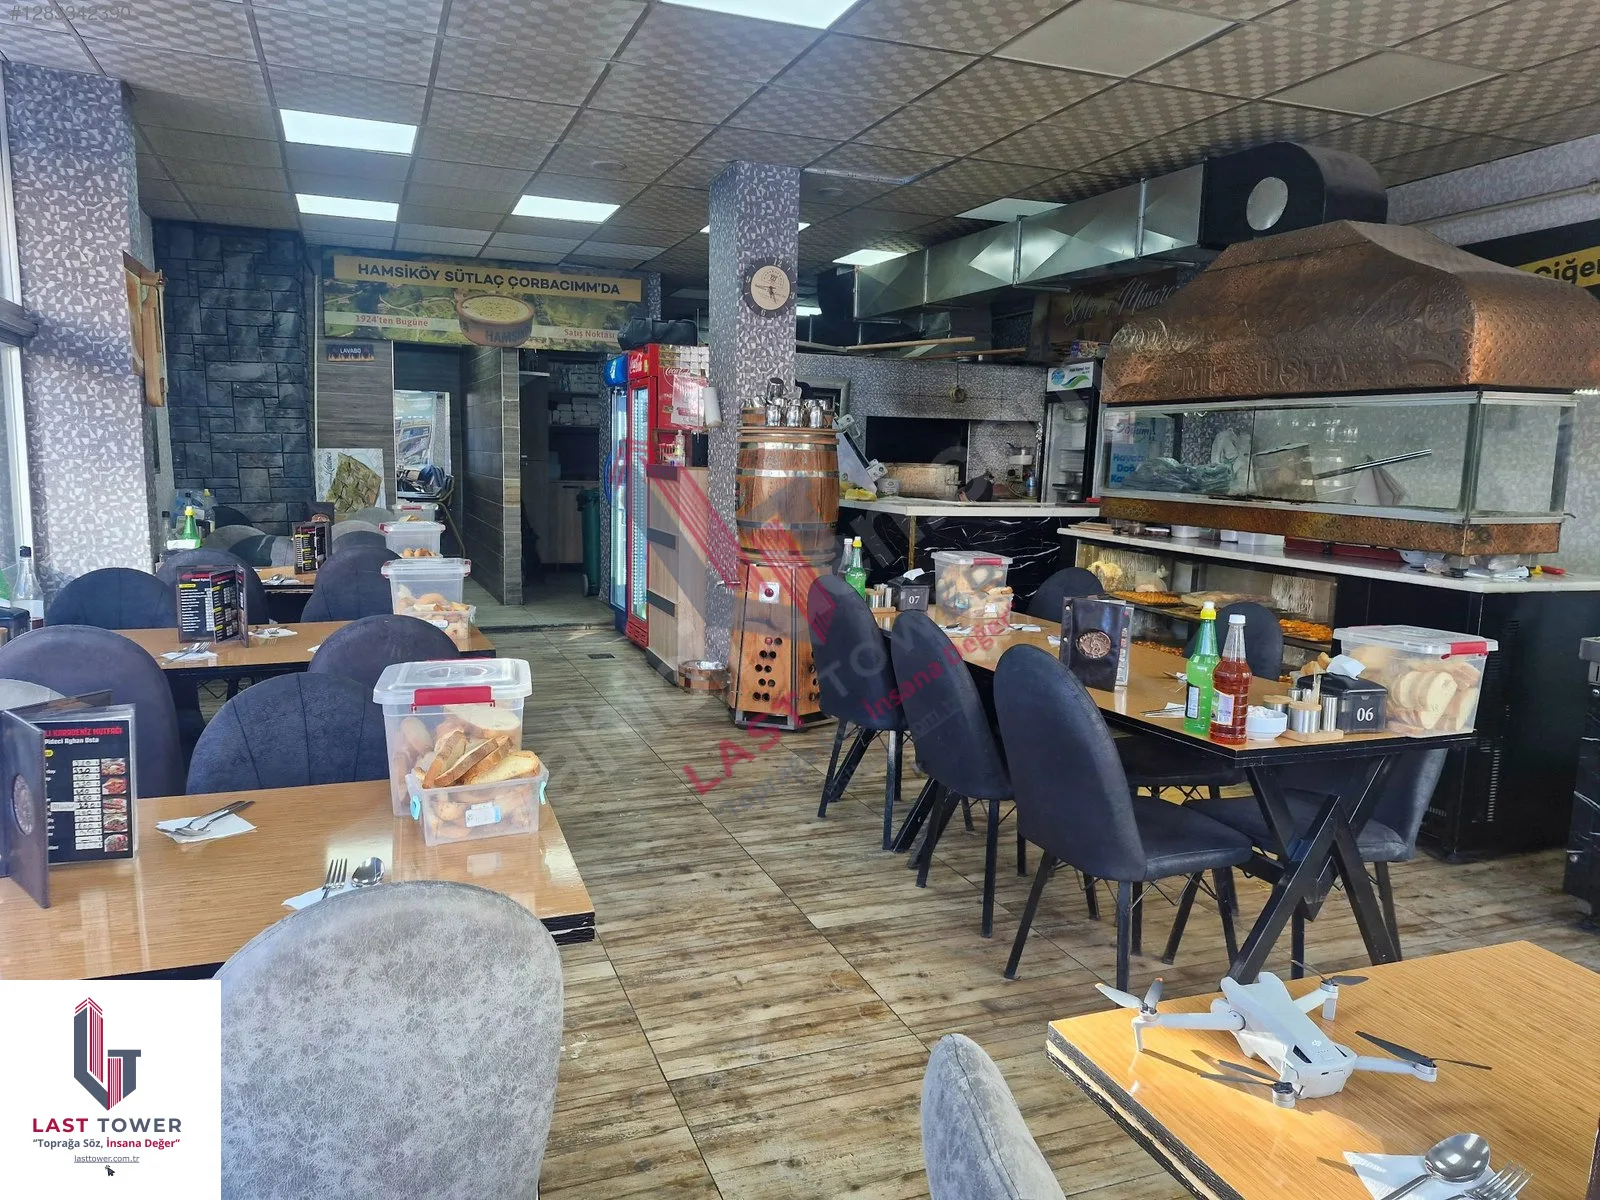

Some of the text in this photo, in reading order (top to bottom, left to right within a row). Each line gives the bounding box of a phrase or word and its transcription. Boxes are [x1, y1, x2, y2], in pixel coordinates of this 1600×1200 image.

[358, 263, 621, 295] HAMSİKÖY SÜTLAÇ ÇORBACIMM'DA
[355, 315, 429, 329] 1924'ten Bugüne
[564, 328, 616, 339] Satış Noktası
[908, 595, 920, 604] 07
[1357, 707, 1374, 722] 06
